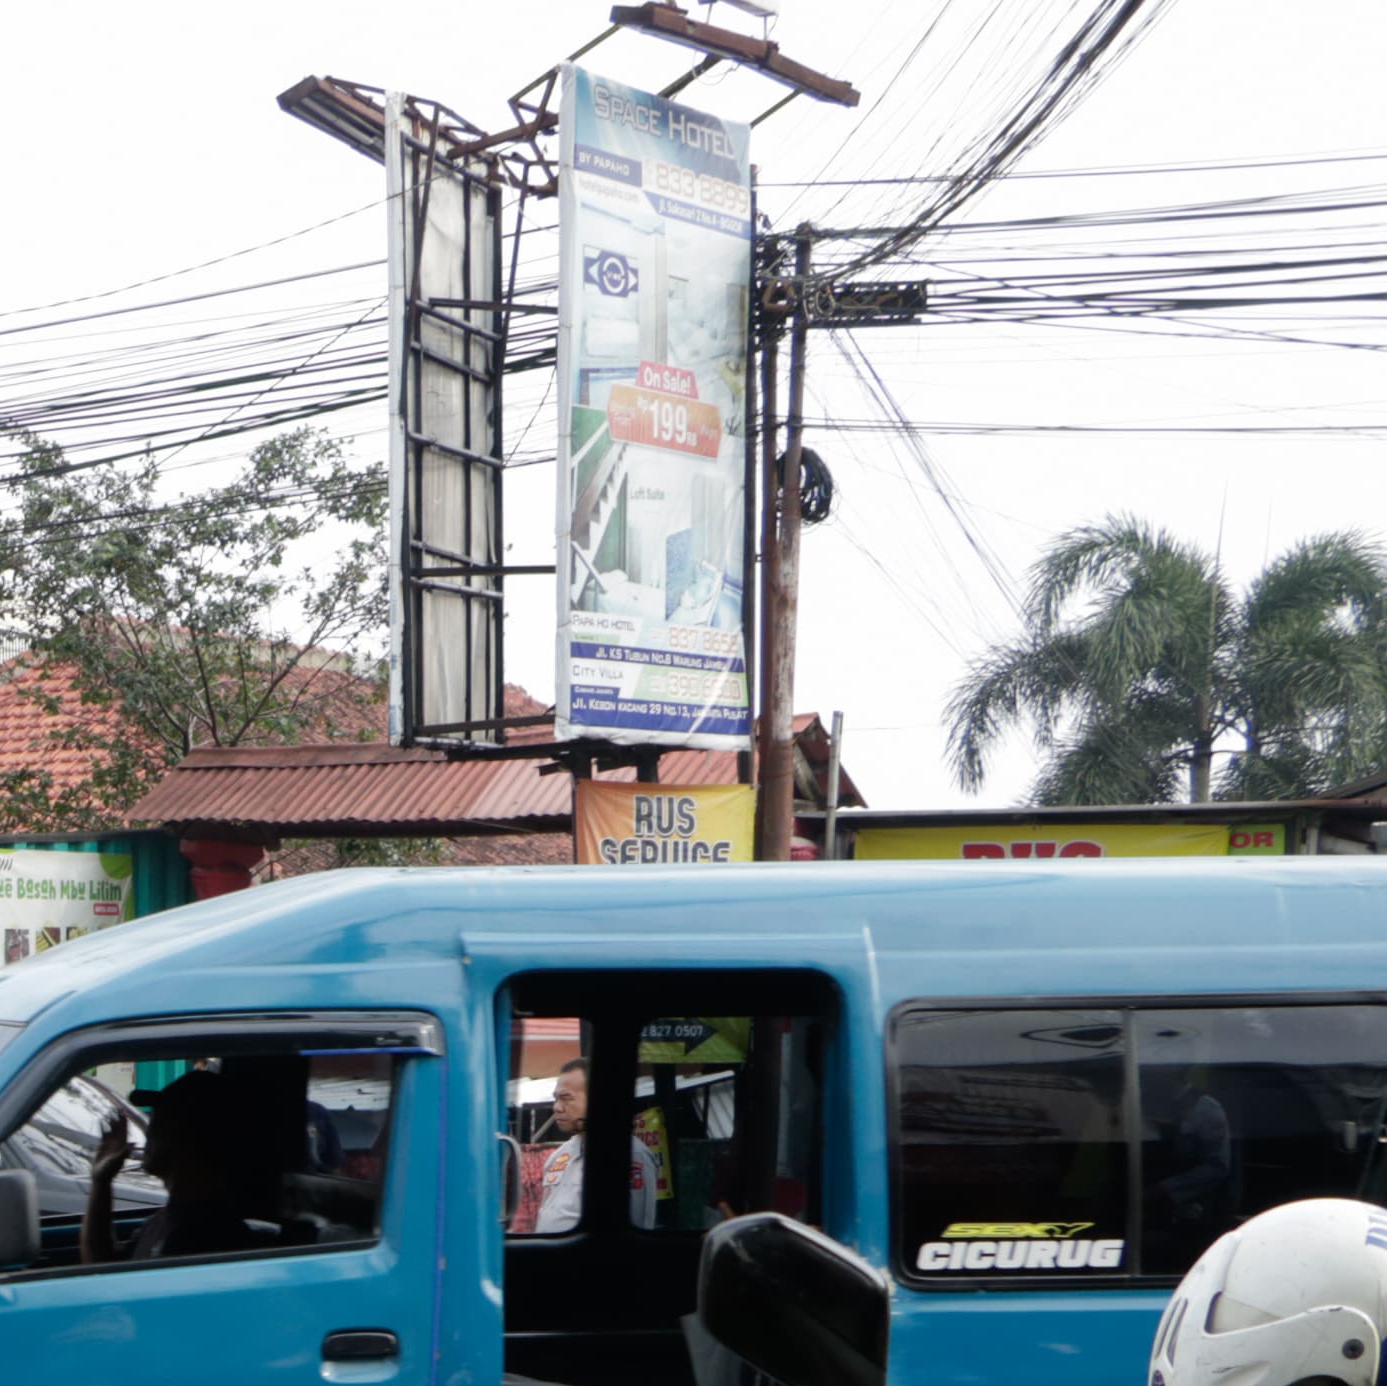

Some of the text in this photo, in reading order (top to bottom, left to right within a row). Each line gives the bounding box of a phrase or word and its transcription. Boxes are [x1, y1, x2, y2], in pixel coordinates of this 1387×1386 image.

[594, 84, 736, 160] SPACE HOTEL
[642, 367, 691, 395] On Sale!
[651, 399, 688, 444] 199
[634, 794, 696, 838] RUS
[16, 878, 56, 899] Basah
[59, 879, 86, 900] Mbu
[89, 879, 122, 902] Lilim
[676, 1024, 703, 1037] 0507
[941, 1222, 1095, 1238] SEXY
[916, 1239, 1125, 1271] CICURUG
